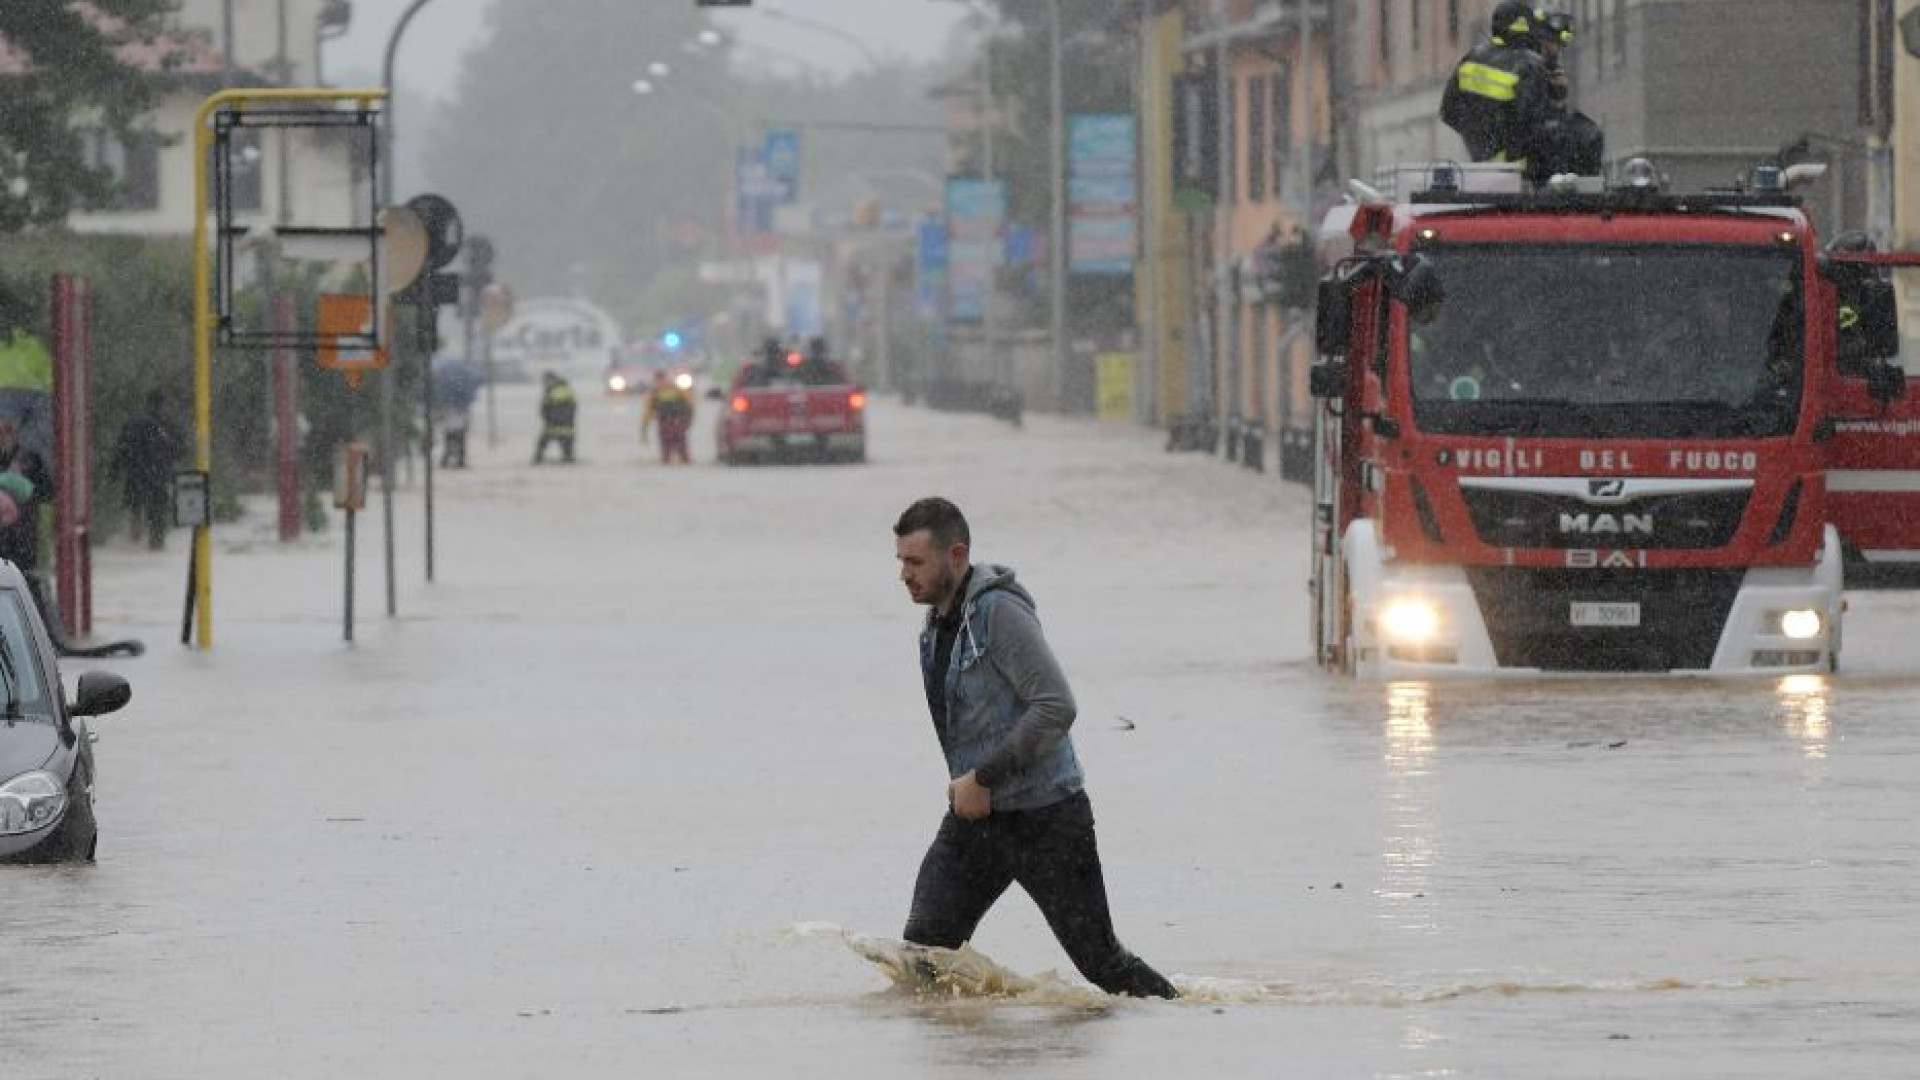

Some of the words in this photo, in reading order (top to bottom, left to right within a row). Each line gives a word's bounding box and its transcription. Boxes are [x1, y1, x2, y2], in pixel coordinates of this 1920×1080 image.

[1456, 449, 1544, 469] VIGILI
[1580, 450, 1632, 470] DEL
[1670, 450, 1757, 470] FUOCO
[1560, 513, 1653, 534] MAN
[1565, 549, 1647, 568] BAI
